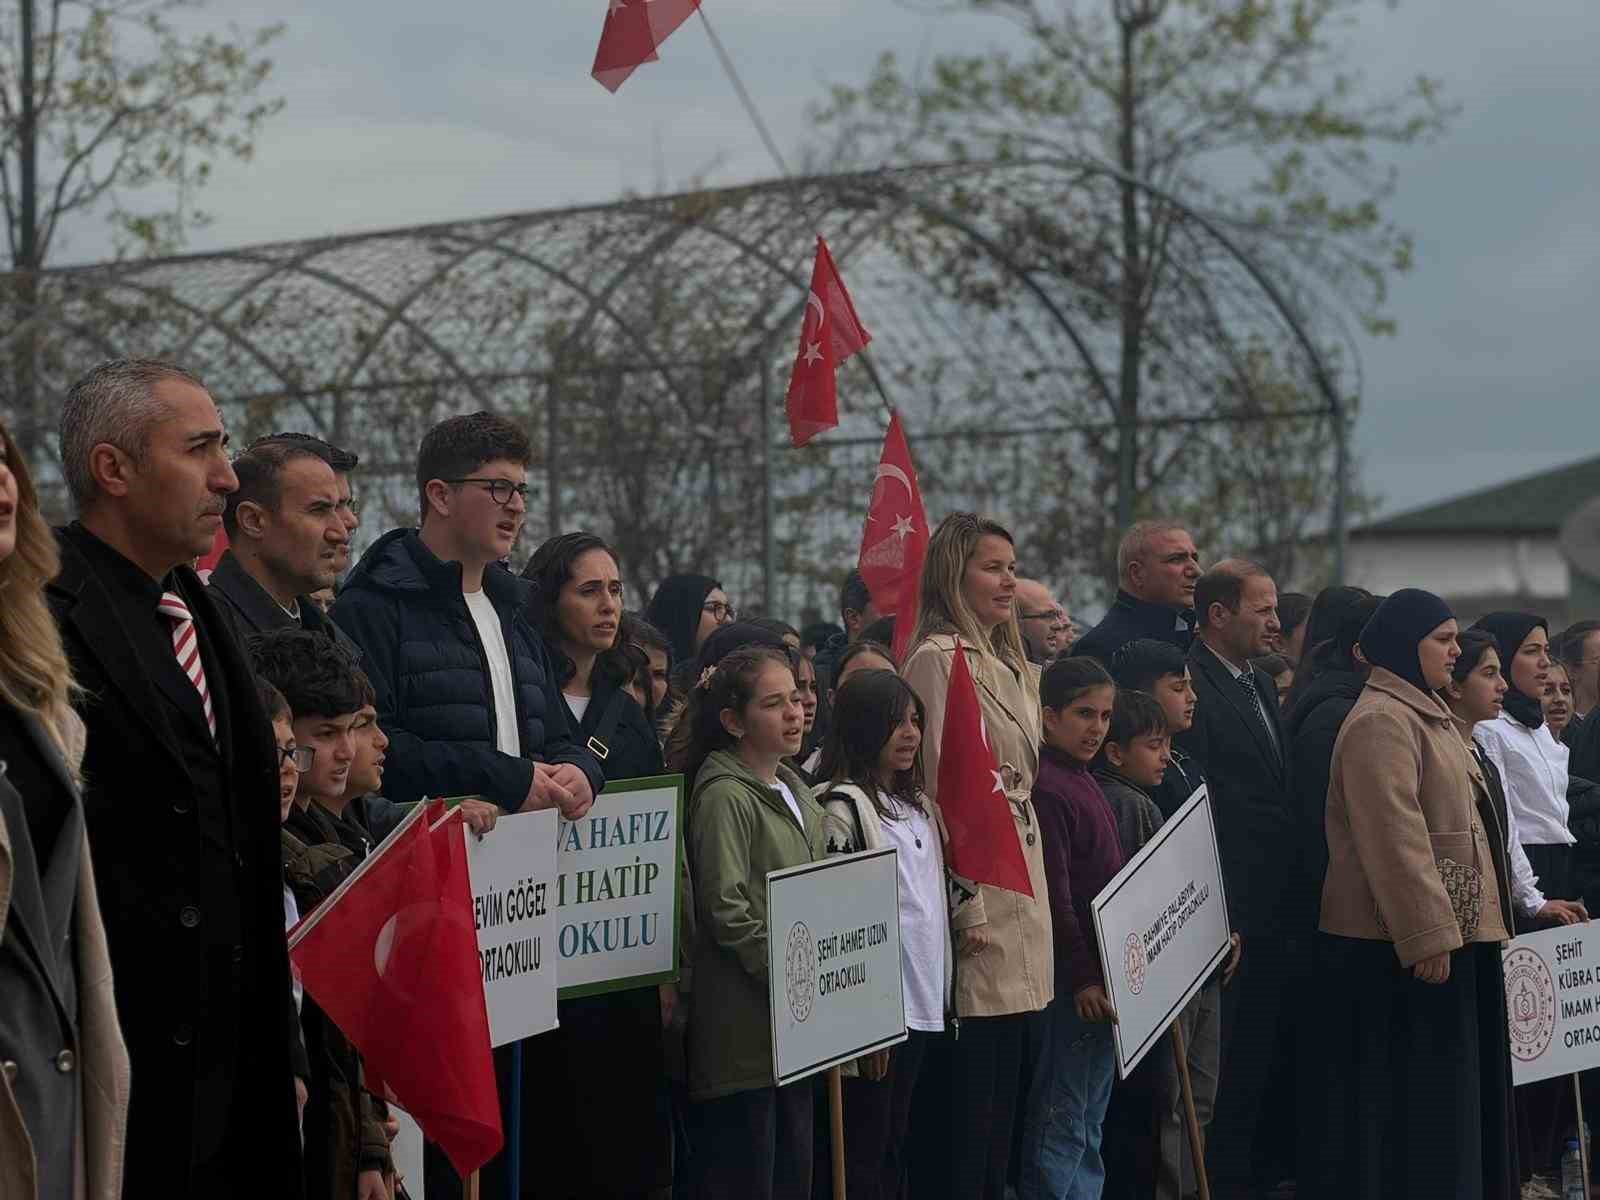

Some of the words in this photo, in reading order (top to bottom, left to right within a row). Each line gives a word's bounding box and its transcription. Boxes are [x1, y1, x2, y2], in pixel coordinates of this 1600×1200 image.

[590, 810, 669, 849] HAFIZ
[576, 855, 659, 904] HATİP
[475, 886, 503, 930] EVİM
[506, 878, 547, 924] GÖĞEZ
[558, 912, 658, 958] OKULU
[817, 931, 838, 967] ŞEHİT
[840, 927, 865, 956] AHMET
[866, 921, 888, 948] UZUN
[1555, 937, 1583, 965] ŞEHİT
[818, 962, 866, 996] ORTAOKULU
[1558, 967, 1593, 990] KÜBRA
[1561, 996, 1593, 1019] İMAM
